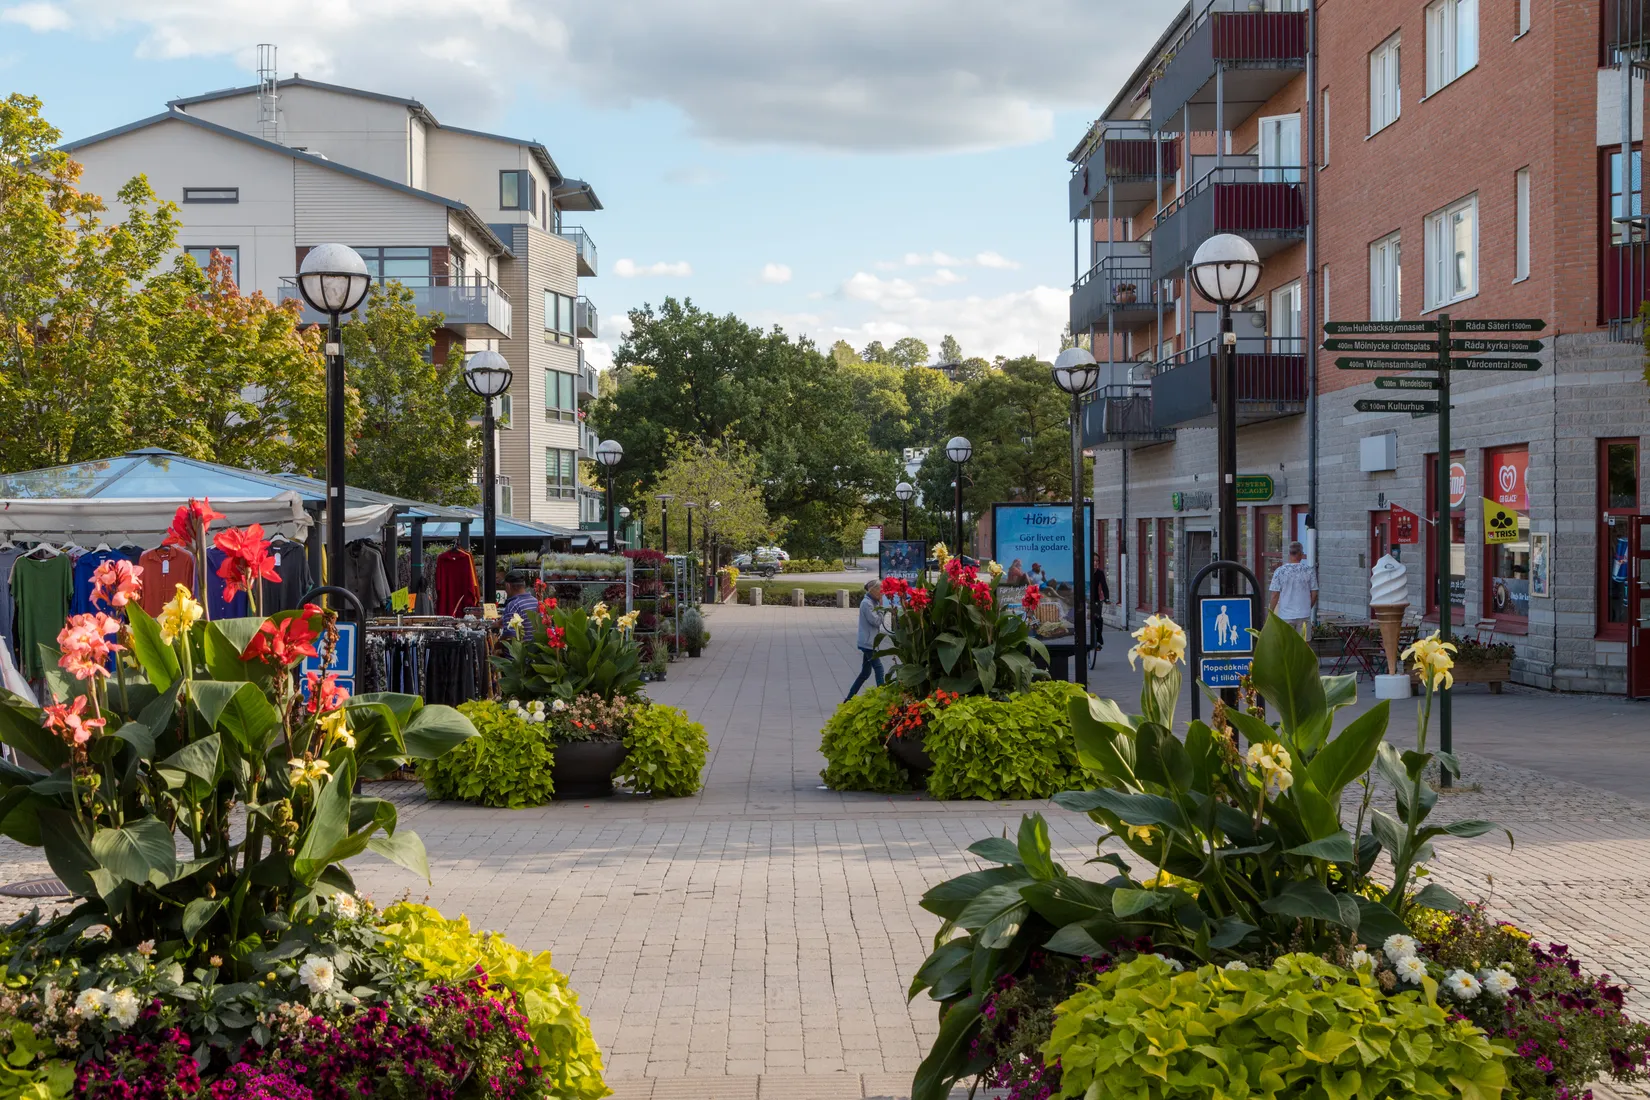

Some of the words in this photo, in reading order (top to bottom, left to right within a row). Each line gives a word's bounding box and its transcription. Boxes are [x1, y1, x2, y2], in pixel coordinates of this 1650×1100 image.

[1465, 321, 1486, 330] Råda
[1487, 321, 1510, 330] Säteri
[1354, 341, 1390, 351] Mölnlycke
[1391, 341, 1431, 351] idrottsplats
[1464, 340, 1485, 349] Råda
[1486, 341, 1509, 351] kyrka
[1366, 359, 1427, 369] Wallenstamhallen
[1466, 359, 1510, 369] Vårdcentral
[1399, 379, 1433, 389] Wendelsberg
[1369, 402, 1386, 410] 100m
[1387, 402, 1425, 411] Kulturhus
[1023, 513, 1057, 525] Hönö
[1019, 533, 1035, 542] Gör
[1036, 533, 1055, 542] livet
[1495, 529, 1517, 538] TRISS
[1015, 543, 1039, 551] smula
[1040, 543, 1071, 553] godare.
[1203, 664, 1250, 673] Mopedåknin
